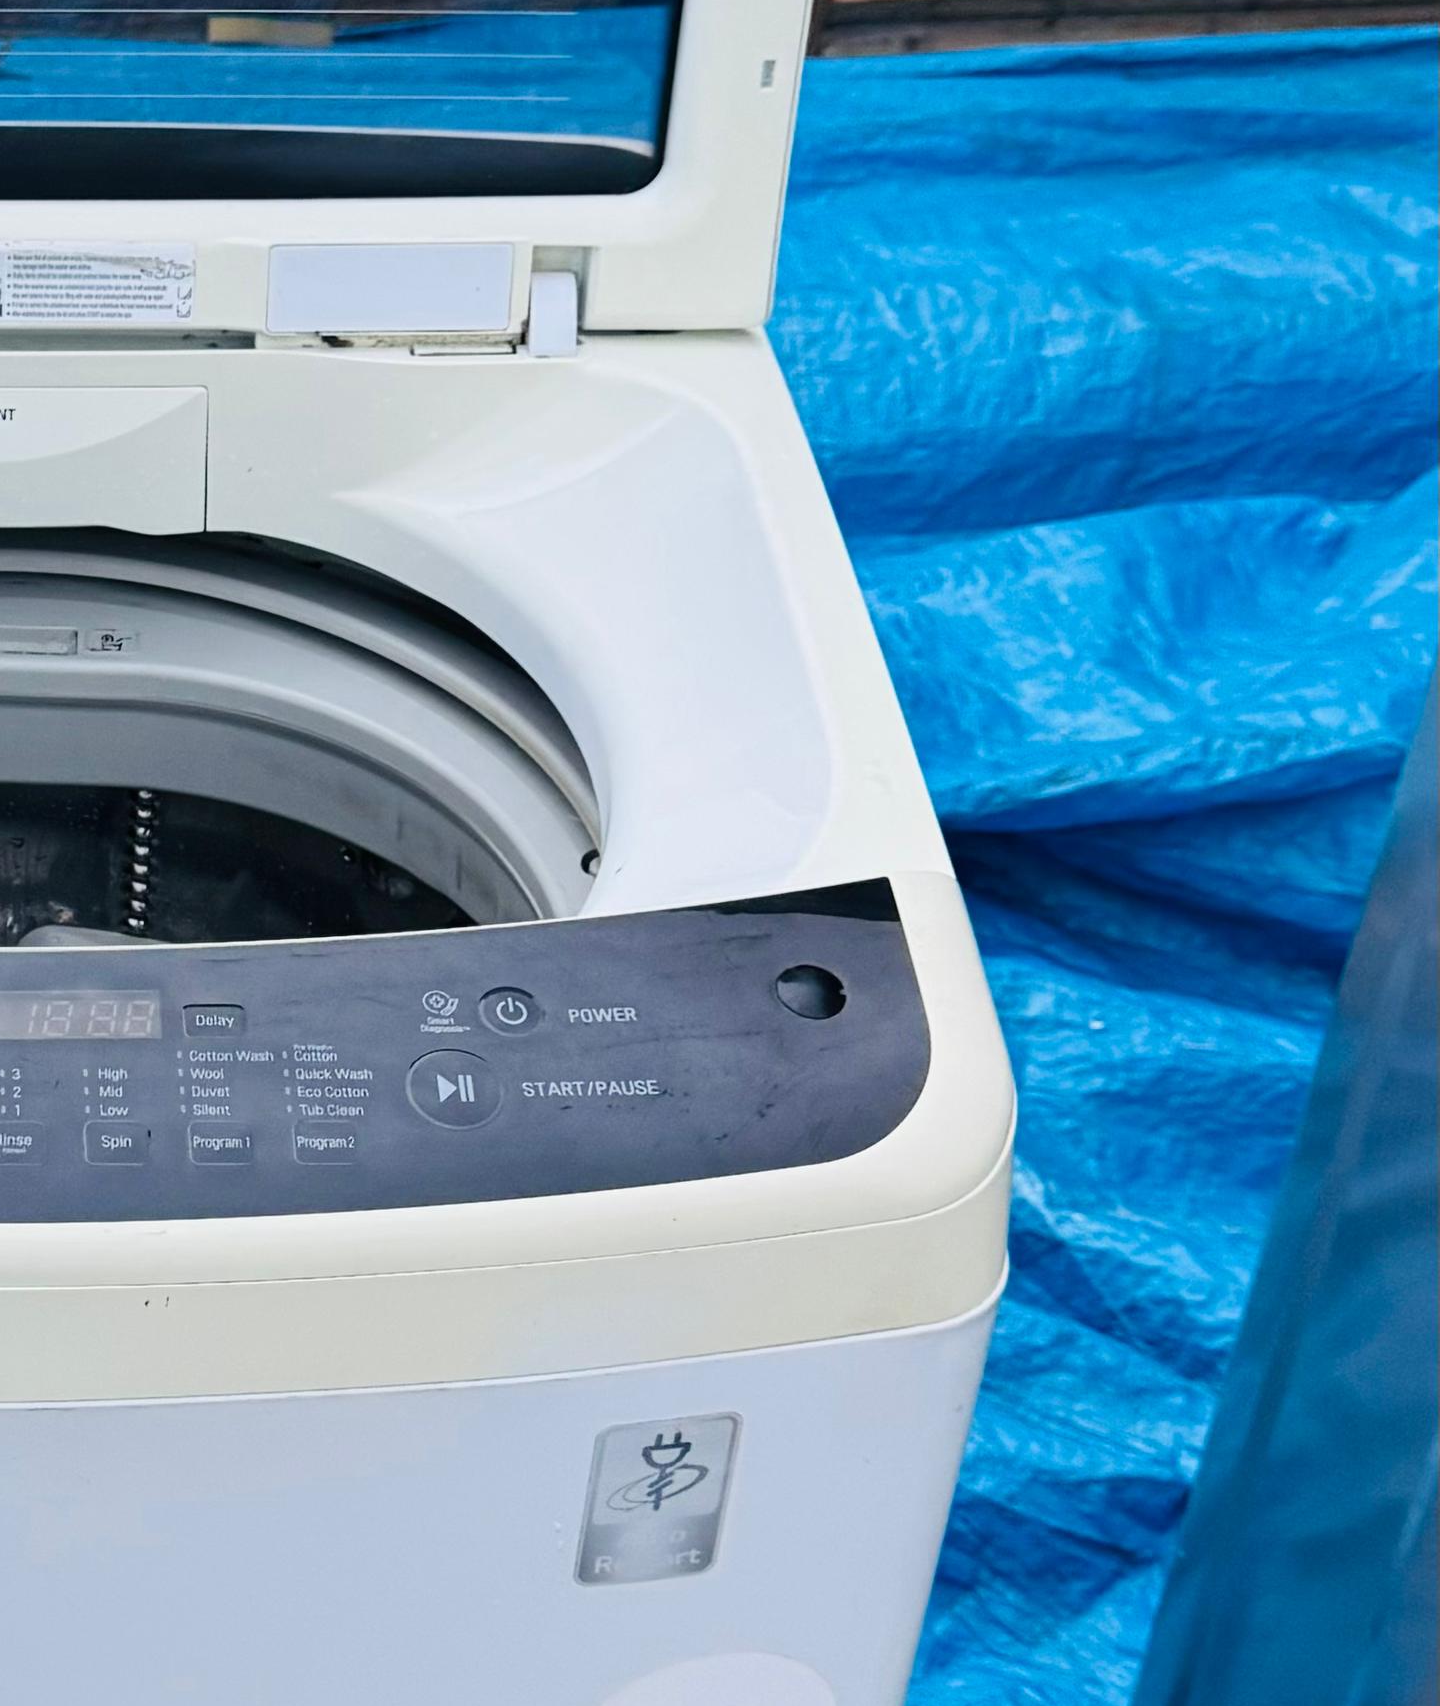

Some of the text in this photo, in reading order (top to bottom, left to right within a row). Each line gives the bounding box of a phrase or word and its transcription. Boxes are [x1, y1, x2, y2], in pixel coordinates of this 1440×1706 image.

[195, 1014, 235, 1029] Delay
[568, 1007, 638, 1024] POWER
[189, 1050, 274, 1062] Cotton Wash
[293, 1050, 338, 1062] Cotton
[11, 1068, 21, 1080] 3
[98, 1068, 128, 1082] High
[190, 1068, 224, 1080] Wool
[295, 1068, 373, 1081] Quick Wash
[12, 1086, 22, 1099] 2
[99, 1086, 123, 1098] Mid
[191, 1086, 230, 1098] Duvet
[297, 1086, 369, 1098] Eco Cotton
[521, 1079, 660, 1097] START/PAUSE
[99, 1104, 129, 1117] Low
[192, 1104, 231, 1117] Silent
[299, 1104, 364, 1117] Tub Clean
[101, 1134, 132, 1150] Spin
